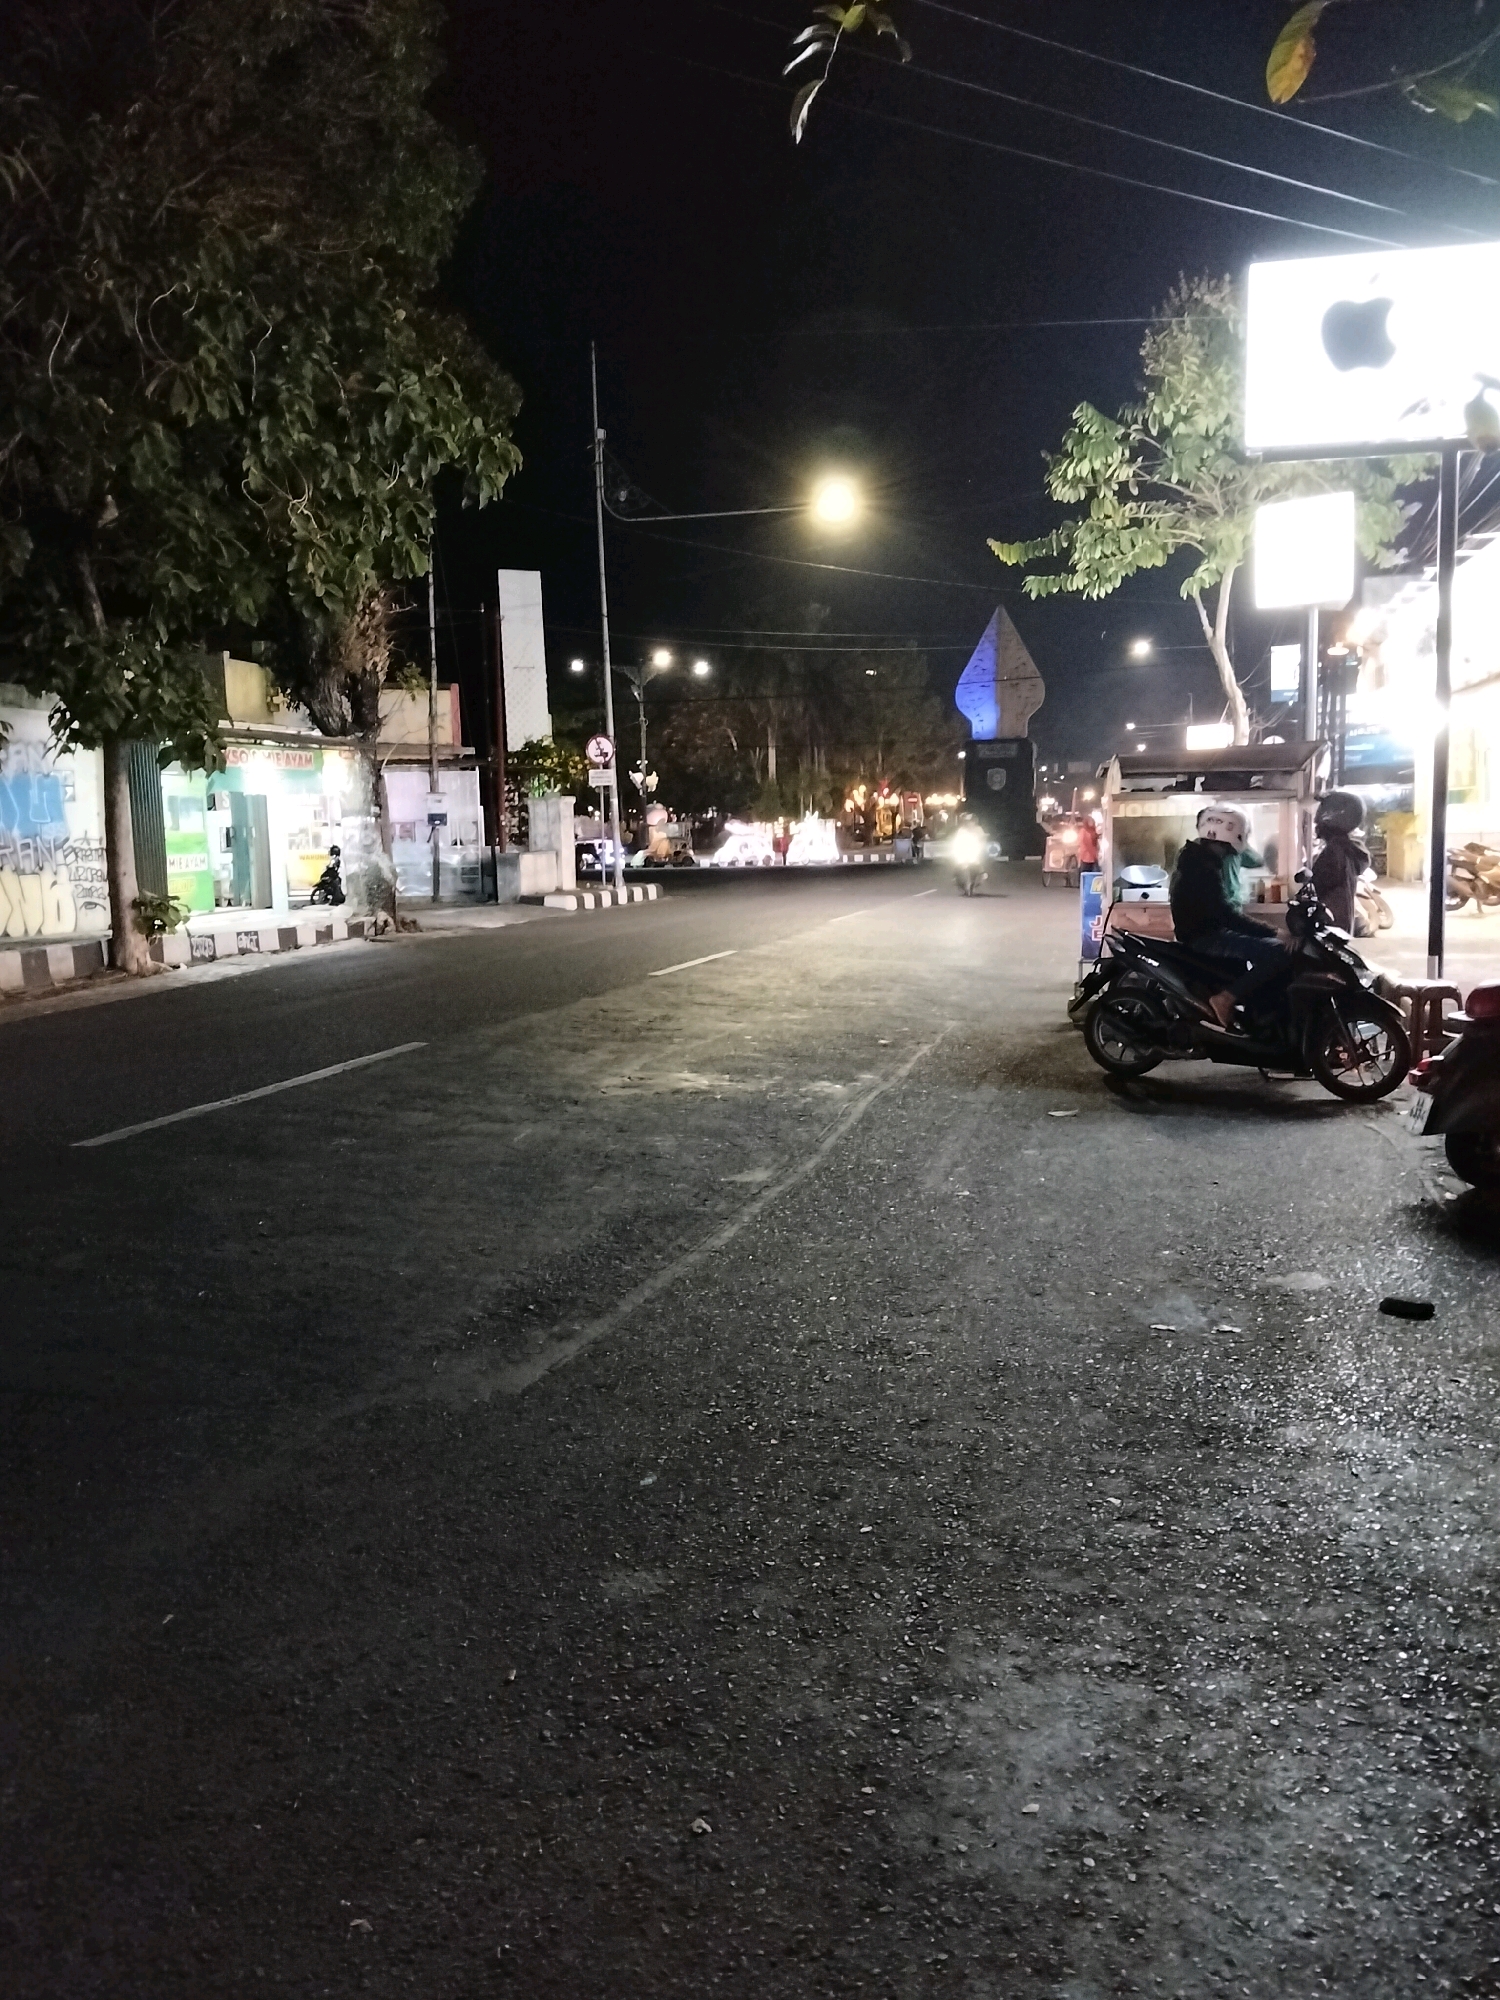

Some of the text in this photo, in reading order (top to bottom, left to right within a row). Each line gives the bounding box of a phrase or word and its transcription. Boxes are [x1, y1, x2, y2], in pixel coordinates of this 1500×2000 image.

[284, 751, 313, 768] AYAM
[168, 856, 207, 870] MIE AYAM
